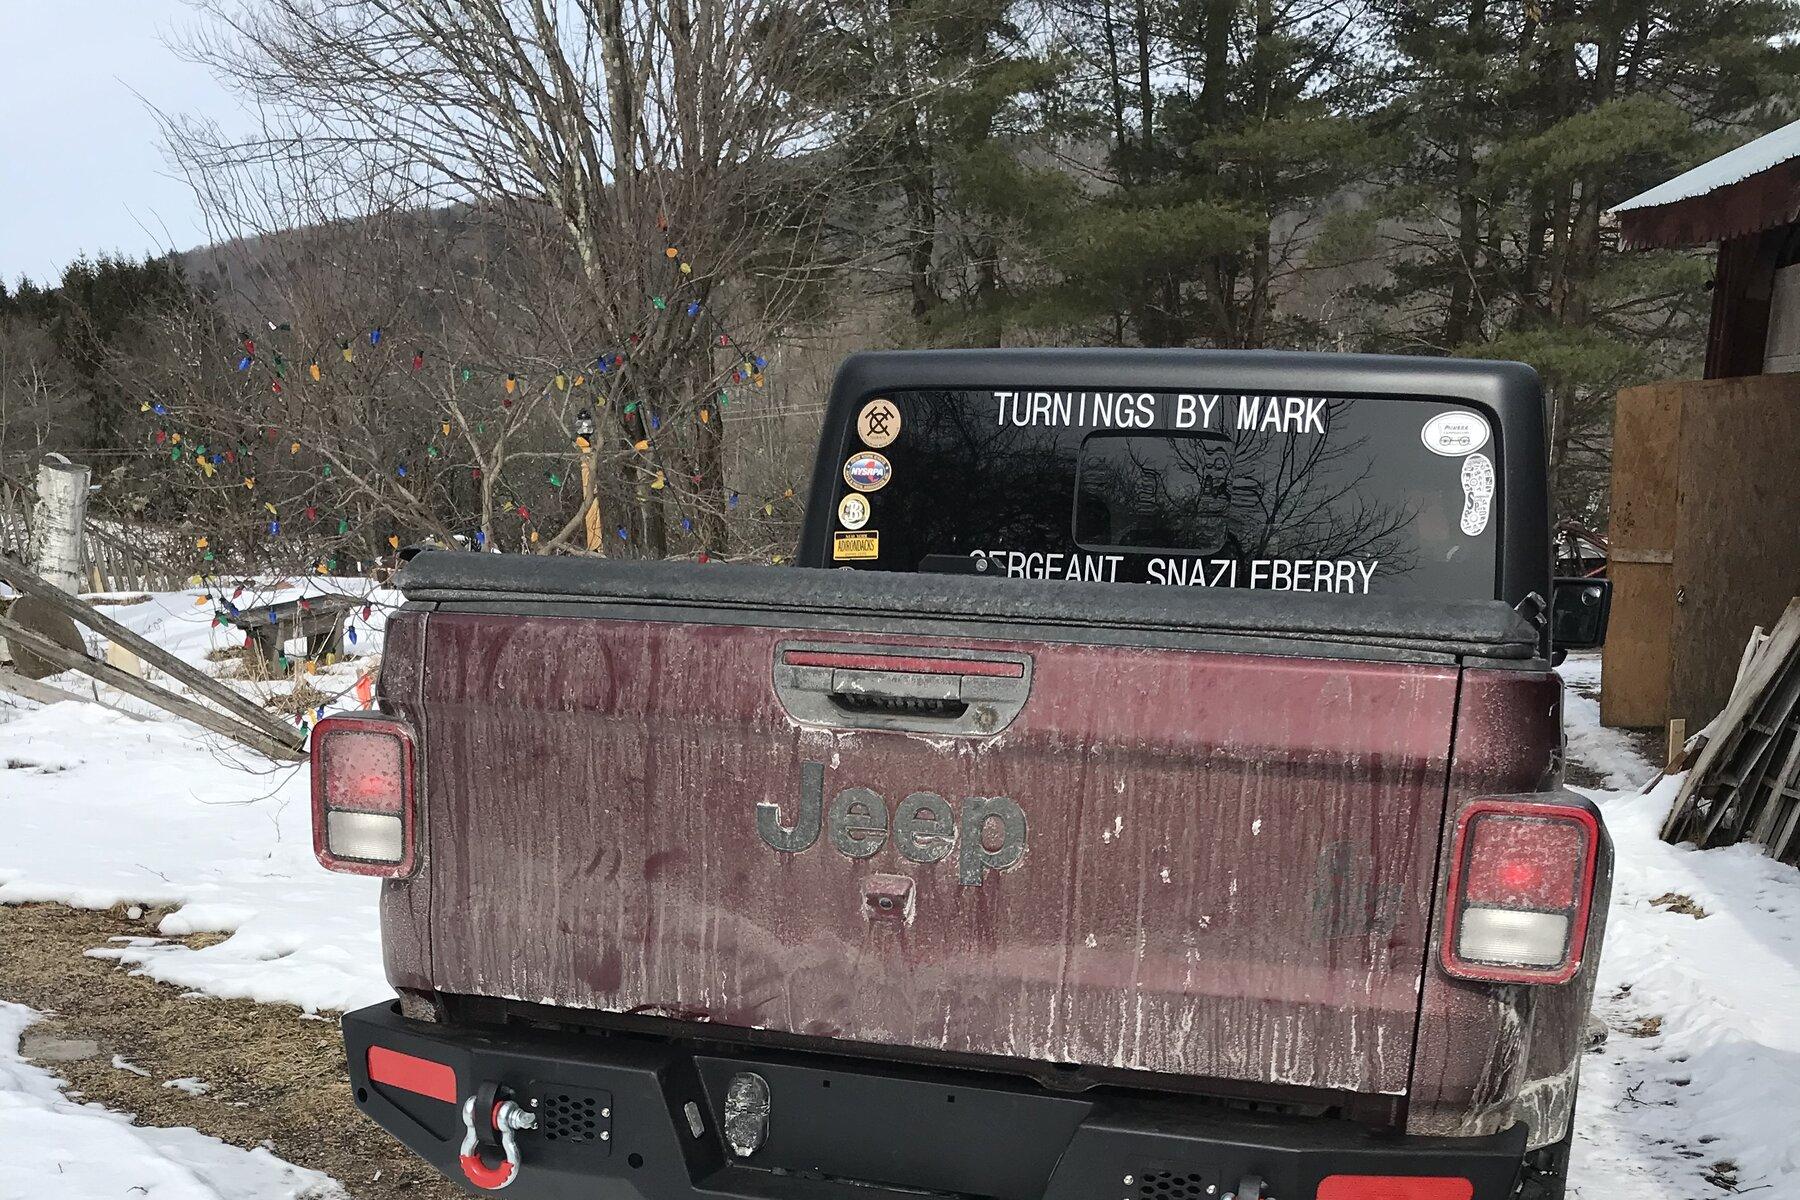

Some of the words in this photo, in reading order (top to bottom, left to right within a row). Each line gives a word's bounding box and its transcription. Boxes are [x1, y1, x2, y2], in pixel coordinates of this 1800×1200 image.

[994, 392, 1155, 428] TURNINGS
[1176, 394, 1219, 429] BY
[1236, 396, 1327, 434] MARK
[837, 539, 875, 552] ADIRONDACKS
[757, 759, 1027, 886] Jeep
